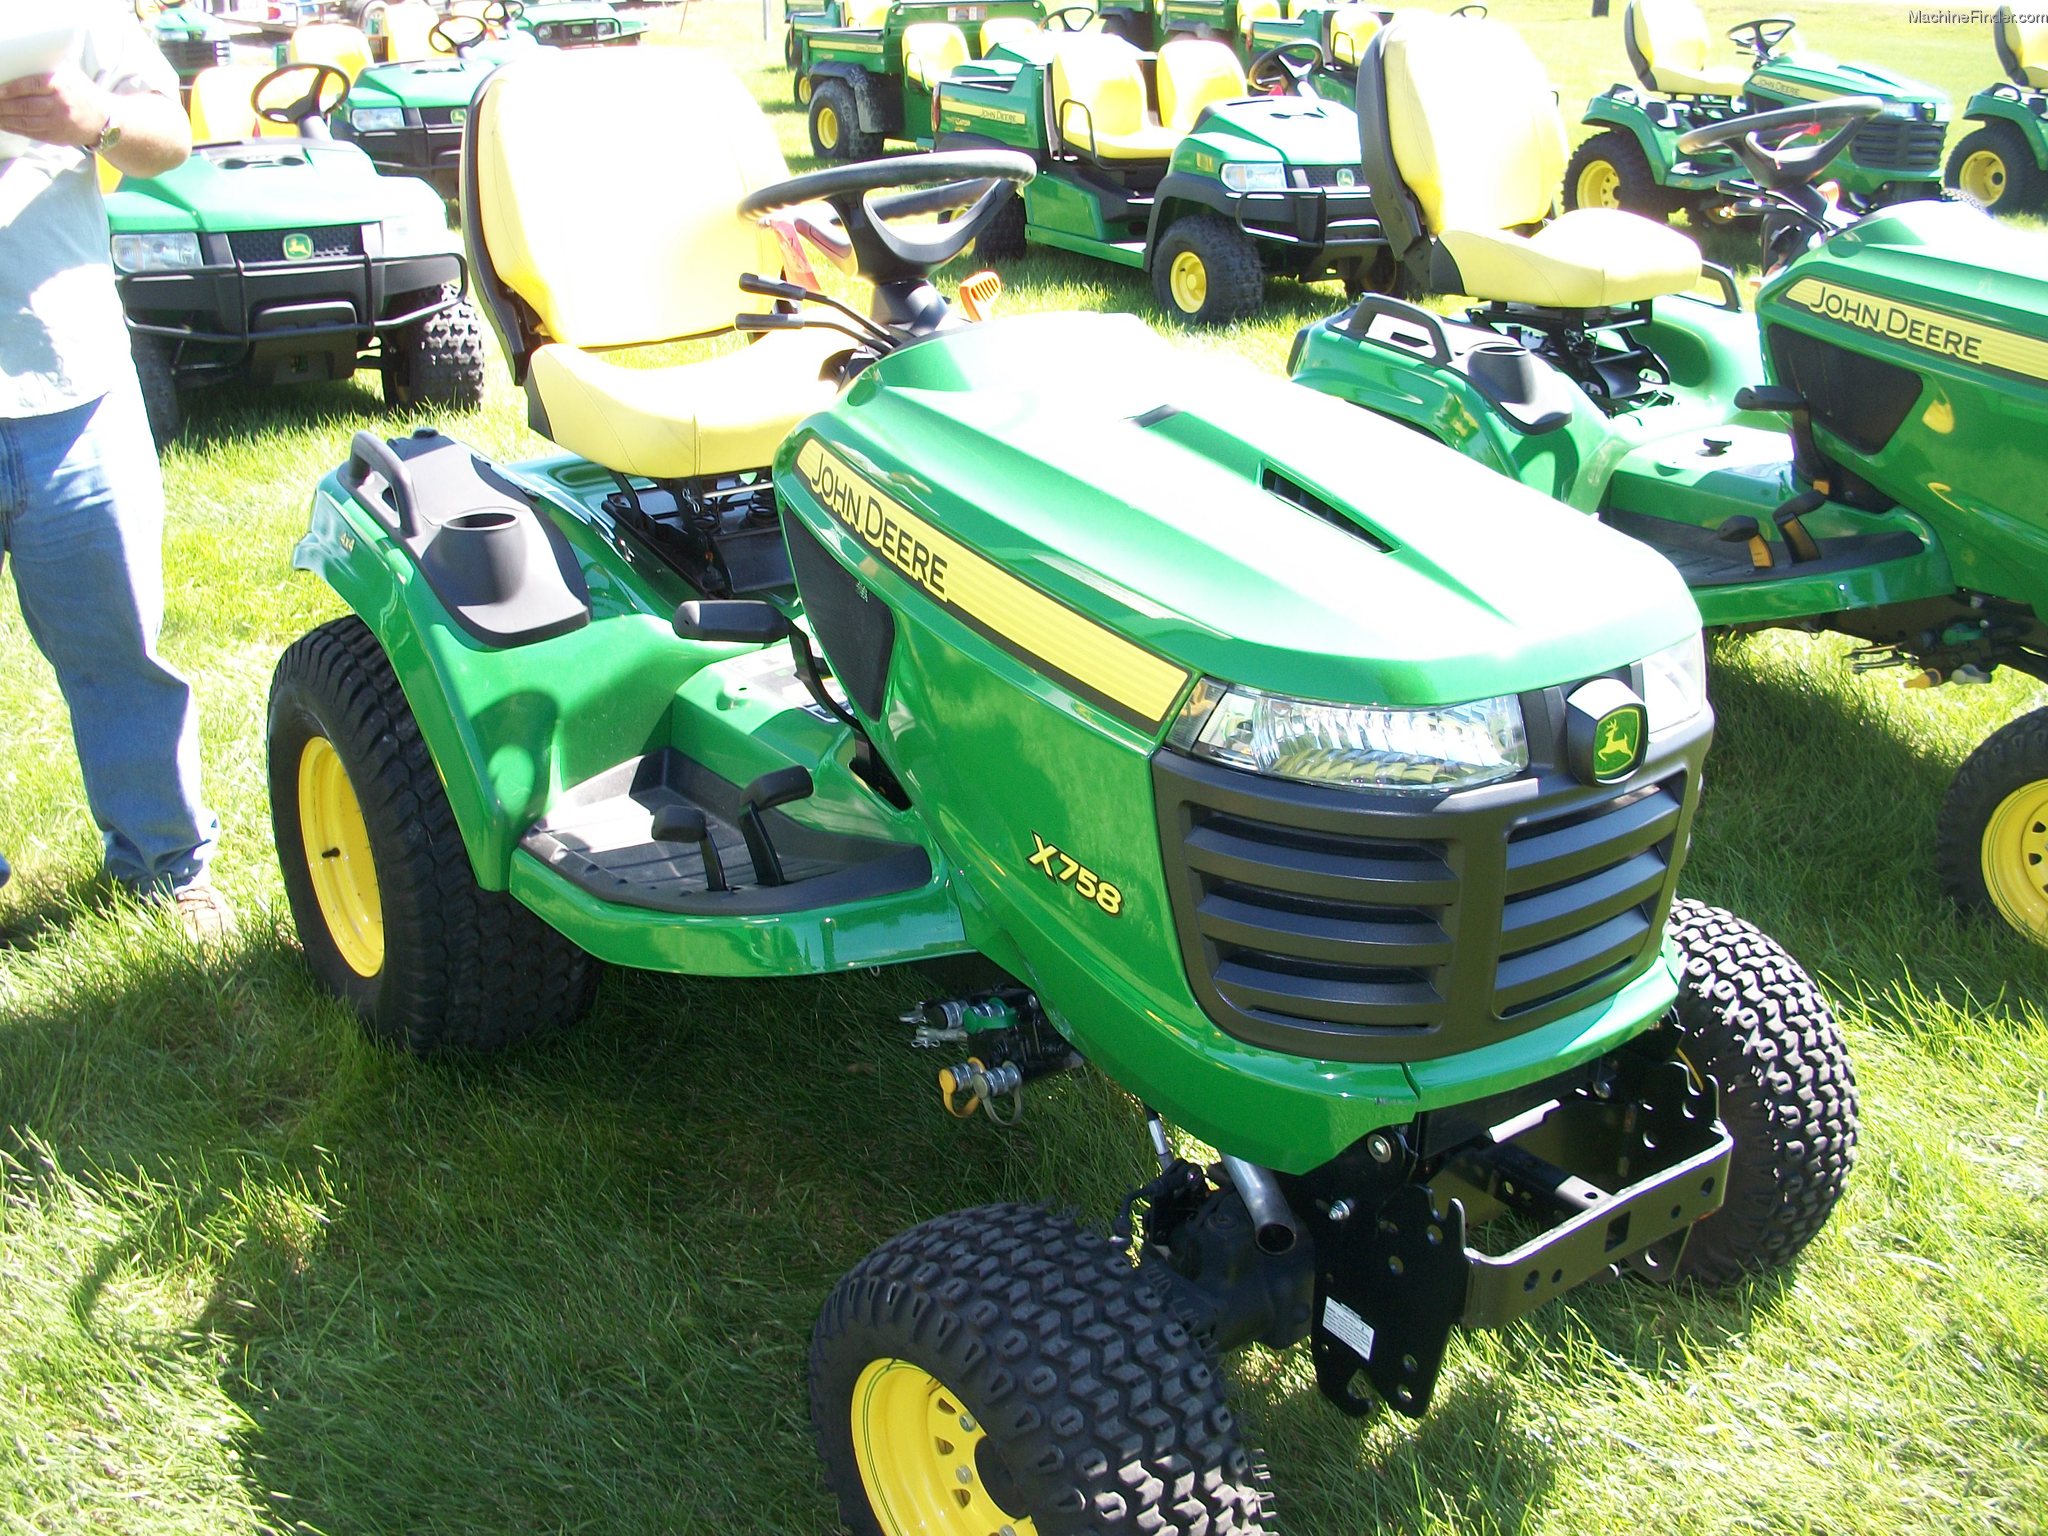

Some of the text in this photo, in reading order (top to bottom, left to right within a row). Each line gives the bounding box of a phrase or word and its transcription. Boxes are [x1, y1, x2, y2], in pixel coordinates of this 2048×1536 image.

[1757, 78, 1800, 96] JOHN DEERE
[1809, 286, 1983, 361] JOHN DEERE
[811, 452, 949, 595] JOHN DEERE
[1026, 829, 1124, 917] X758
